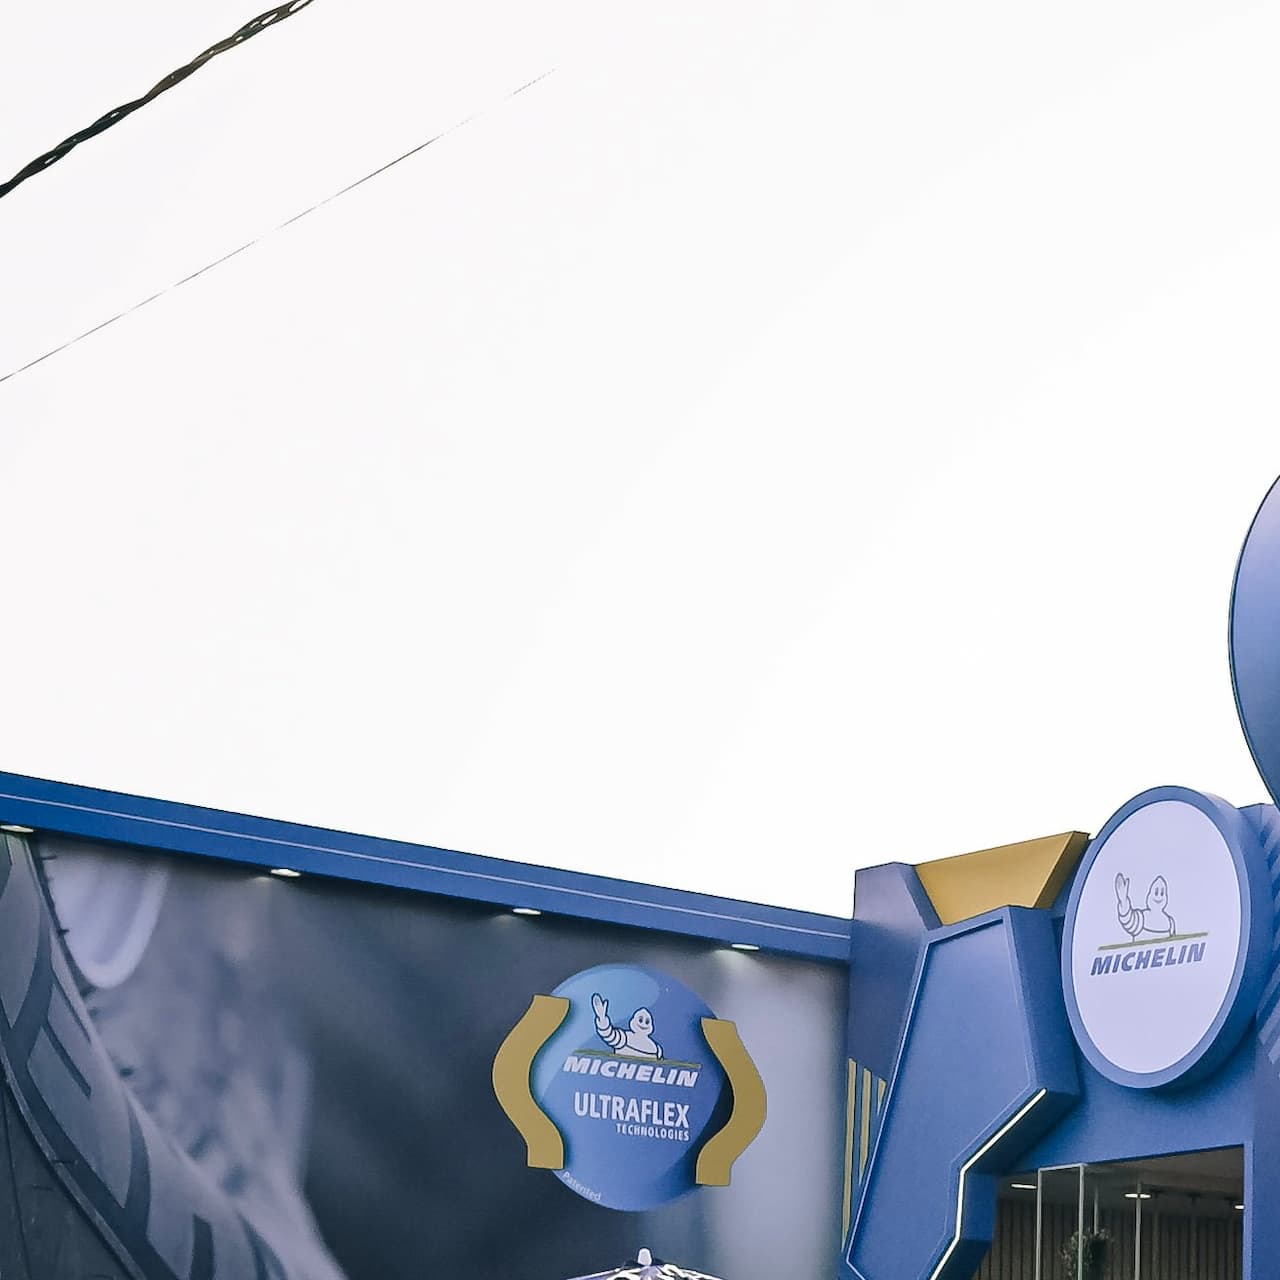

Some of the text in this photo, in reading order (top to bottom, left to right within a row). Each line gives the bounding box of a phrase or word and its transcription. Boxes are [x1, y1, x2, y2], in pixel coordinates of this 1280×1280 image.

[1090, 942, 1206, 976] MICHELIN
[563, 1055, 699, 1088] MICHELIN
[573, 1091, 690, 1128] ULTRAFLEX
[616, 1122, 690, 1142] TECHNOLOGIES
[562, 1170, 602, 1201] Patented
